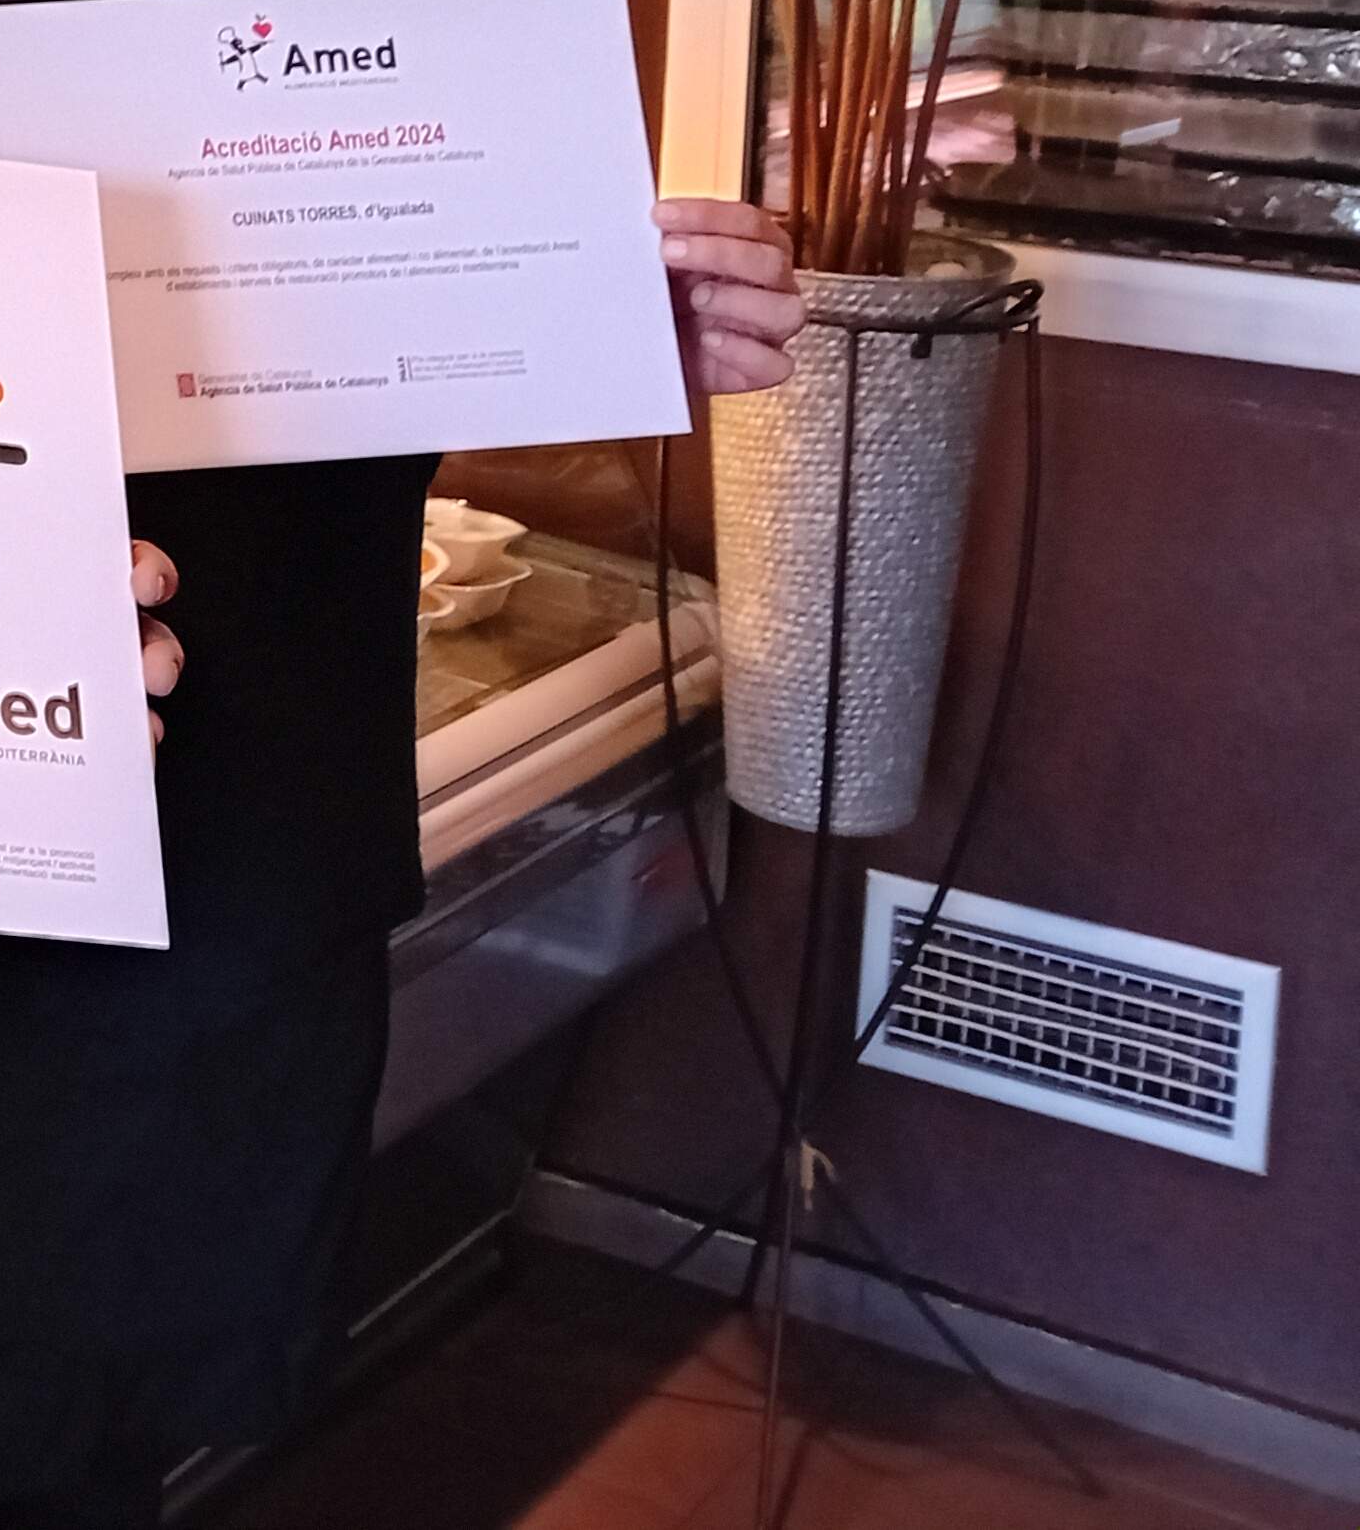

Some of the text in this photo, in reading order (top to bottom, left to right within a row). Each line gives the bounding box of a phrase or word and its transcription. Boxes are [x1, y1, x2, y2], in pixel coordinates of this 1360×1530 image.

[283, 36, 397, 76] Amed
[201, 123, 446, 160] Acreditació Amed 2024
[232, 207, 296, 227] CUINATS
